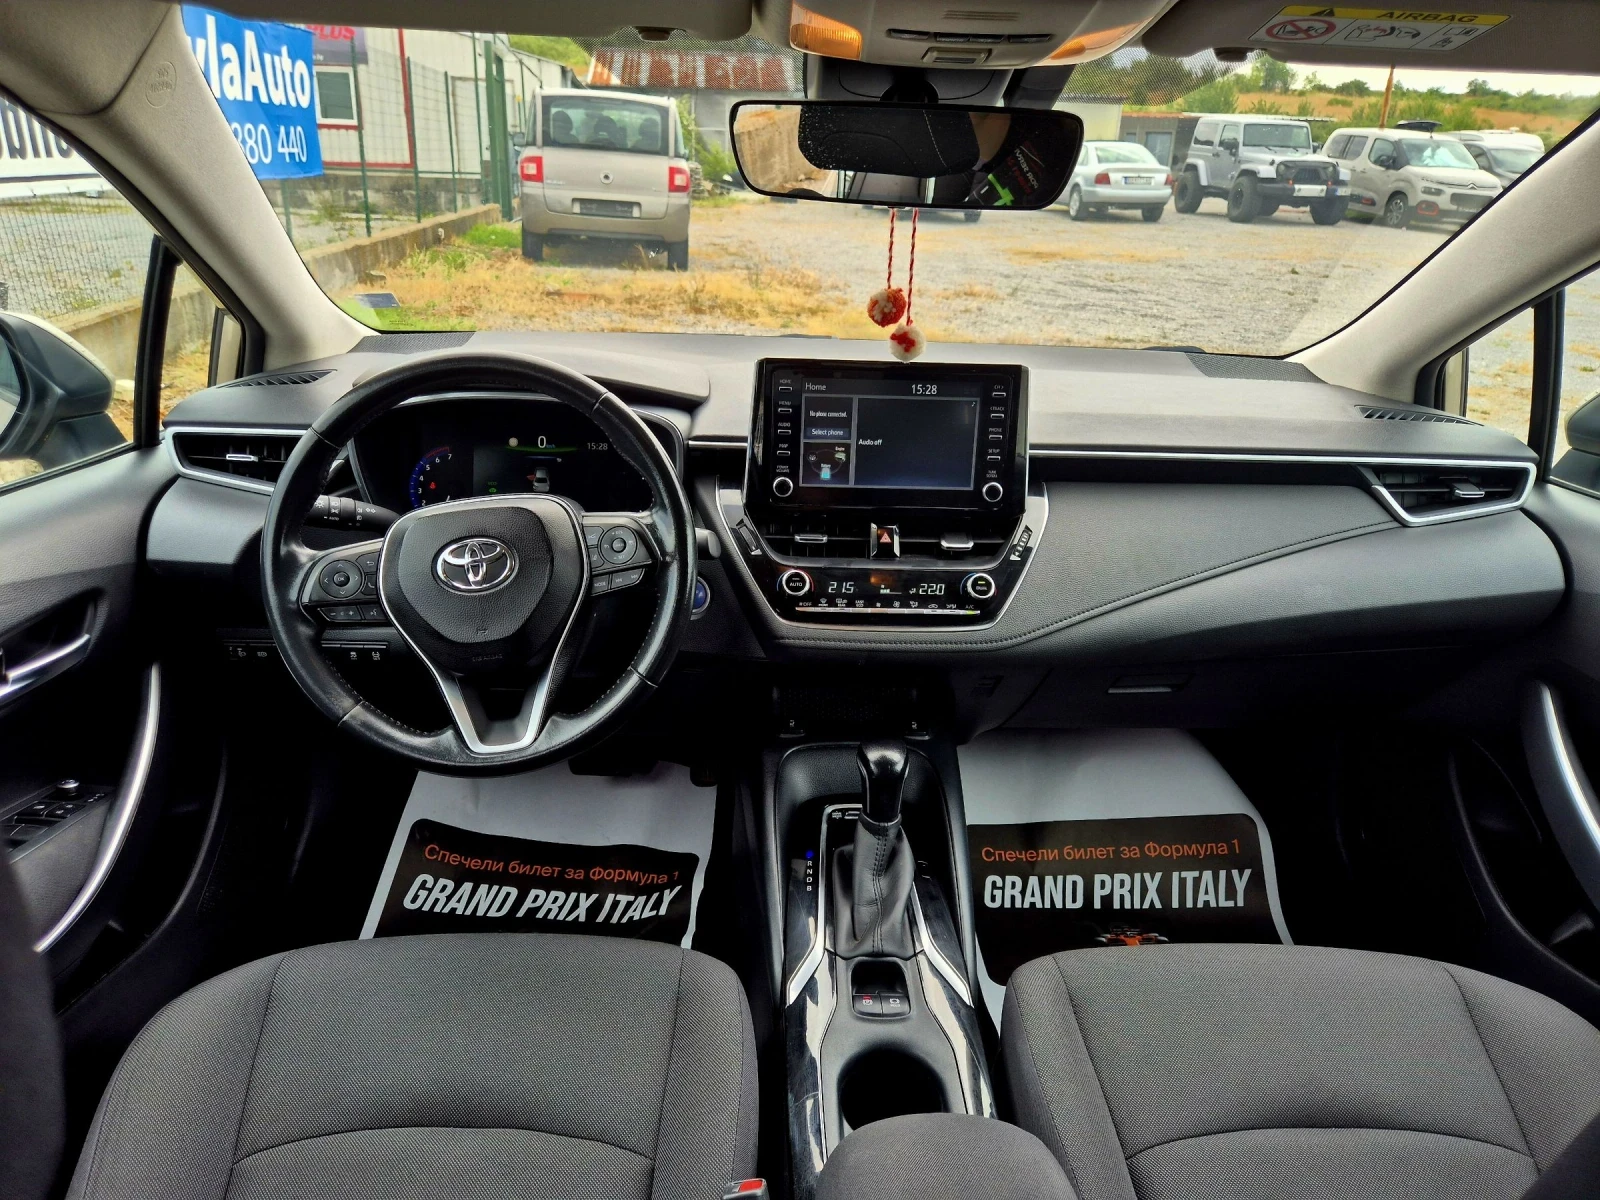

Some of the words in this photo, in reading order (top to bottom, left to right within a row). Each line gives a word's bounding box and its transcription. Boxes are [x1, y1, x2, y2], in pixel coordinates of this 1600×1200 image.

[1376, 11, 1479, 23] AIRBAG
[277, 125, 308, 163] 440
[805, 382, 827, 391] Home
[912, 384, 938, 394] 15:28
[538, 436, 546, 448] 0
[587, 442, 608, 450] 15:28
[982, 846, 1059, 862] Спечели
[1064, 844, 1116, 860] билет
[1120, 846, 1141, 859] за
[1144, 841, 1228, 860] Формула
[1232, 840, 1240, 854] 1
[424, 843, 504, 873] Спечели
[508, 861, 561, 878] билет
[564, 868, 584, 881] за
[589, 866, 668, 885] Формула
[672, 870, 679, 880] 1
[984, 875, 1083, 909] GRAND
[1093, 872, 1162, 909] PRIX
[1171, 868, 1252, 908] ITALY
[403, 874, 518, 917] GRAND
[516, 889, 600, 922] PRIX
[596, 885, 682, 924] ITALY
